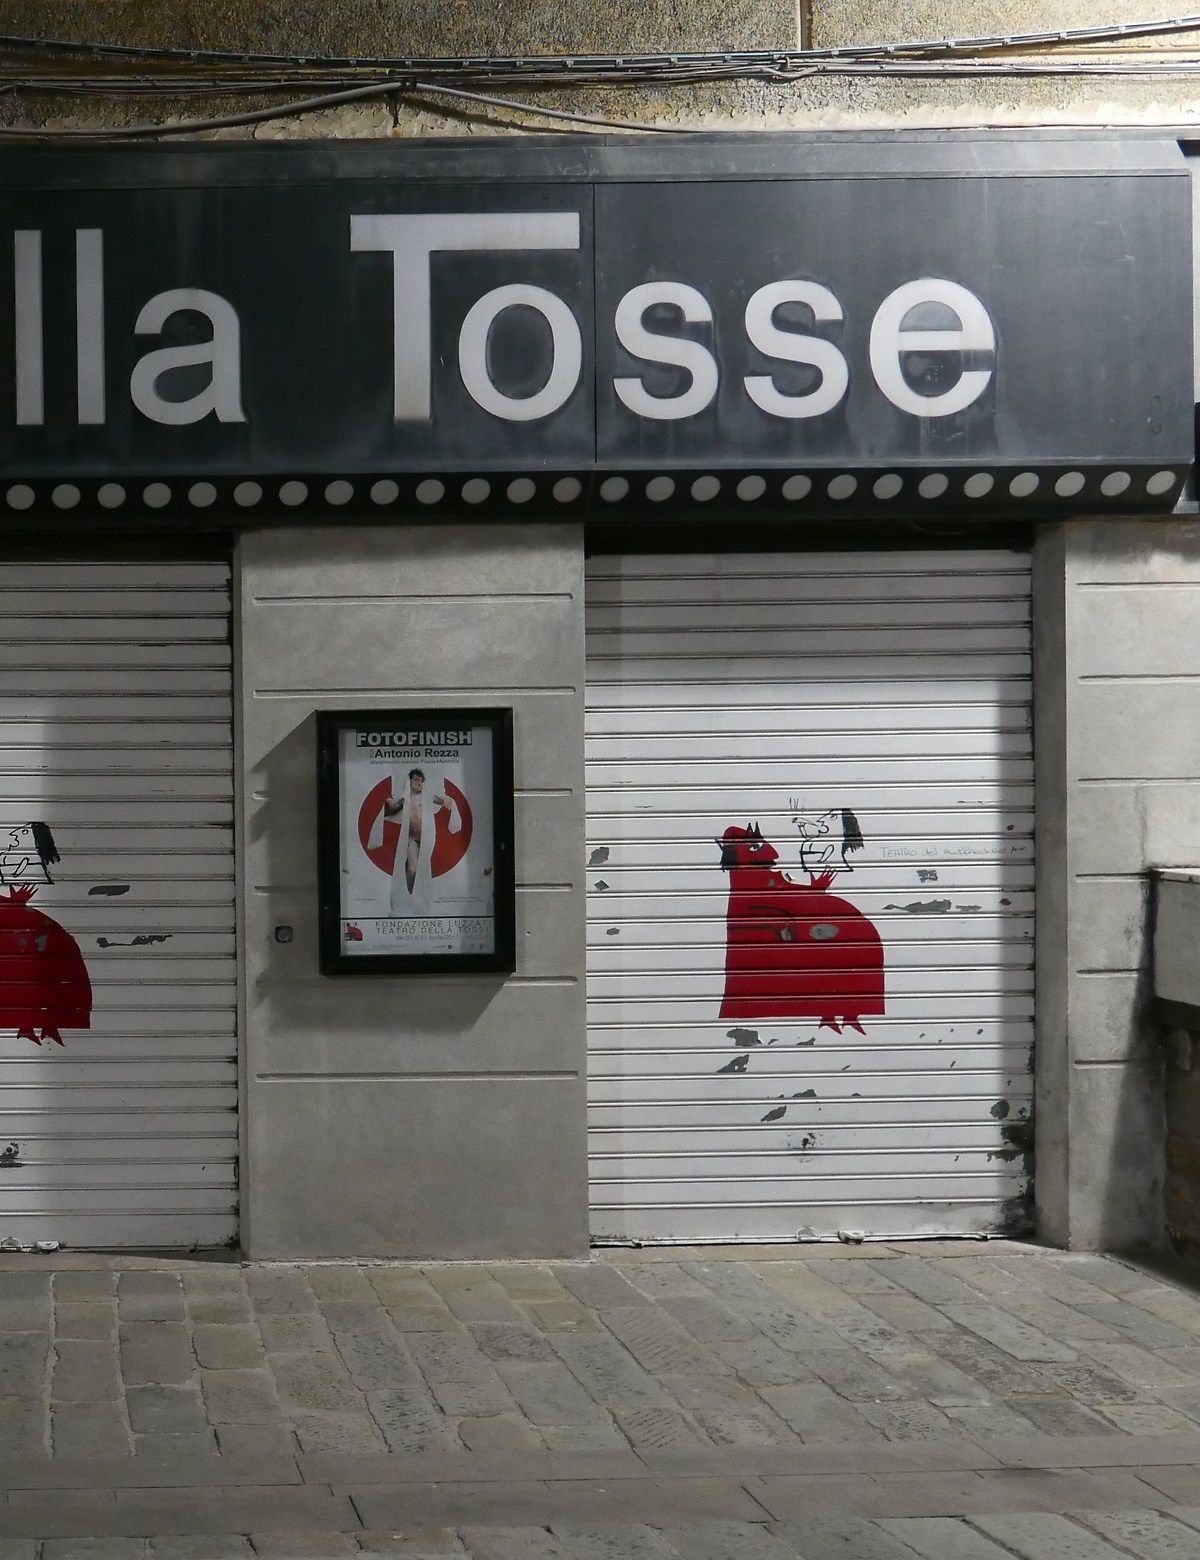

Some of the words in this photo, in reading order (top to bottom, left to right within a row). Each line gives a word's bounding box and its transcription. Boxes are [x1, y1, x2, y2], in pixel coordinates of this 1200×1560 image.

[350, 212, 996, 421] Tosse
[356, 731, 472, 746] FOTOFINISH
[374, 748, 421, 758] Antonio
[424, 748, 459, 757] Rezza
[448, 920, 491, 928] LUZZATI
[377, 927, 416, 935] TEATRO
